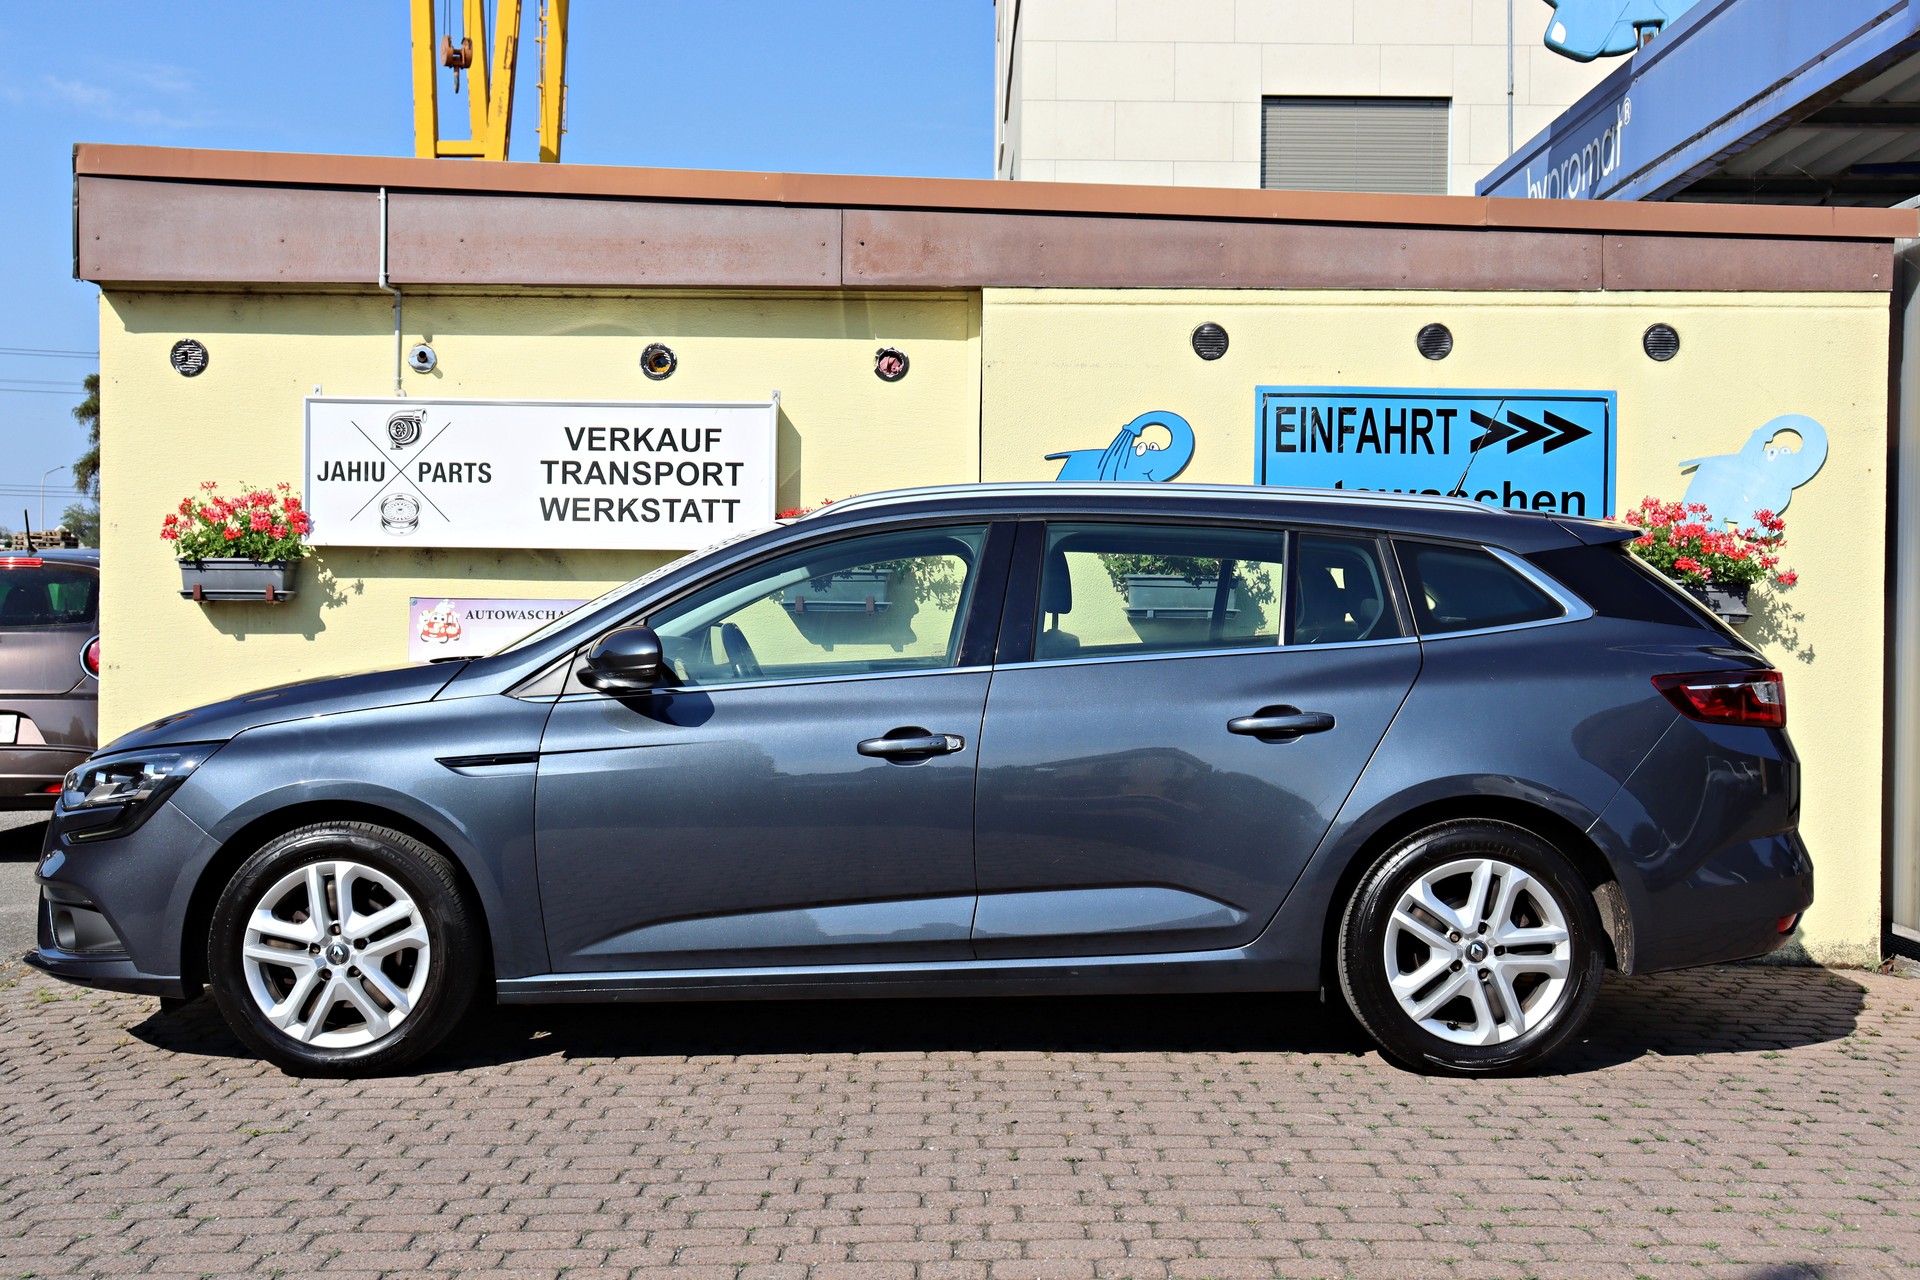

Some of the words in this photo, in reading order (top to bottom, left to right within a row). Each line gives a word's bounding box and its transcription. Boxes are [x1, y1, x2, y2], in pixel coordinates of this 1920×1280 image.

[564, 426, 722, 453] VERKAUF
[1275, 406, 1458, 455] EINFAHRT
[317, 460, 386, 483] JAHIU
[418, 461, 493, 484] PARTS
[540, 460, 745, 487] TRANSPORT
[539, 497, 741, 524] WERKSTATT
[465, 610, 571, 620] AUTOWASCHA
